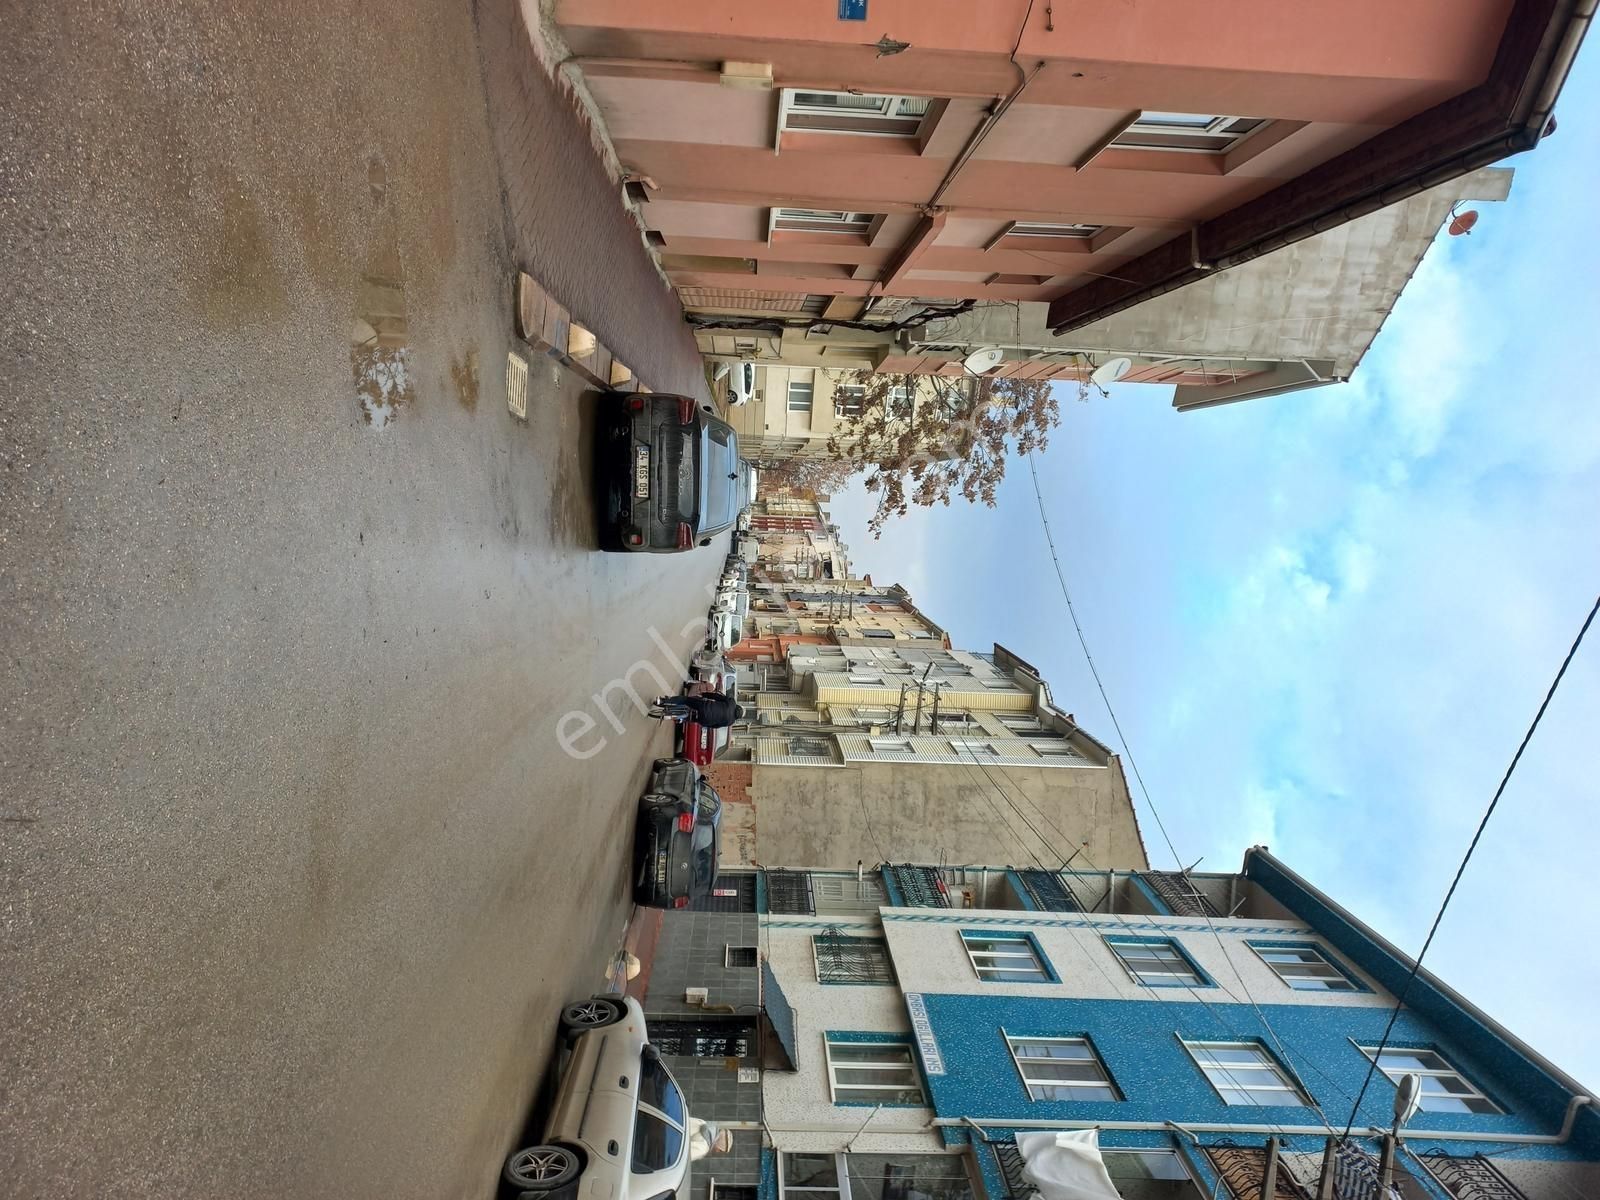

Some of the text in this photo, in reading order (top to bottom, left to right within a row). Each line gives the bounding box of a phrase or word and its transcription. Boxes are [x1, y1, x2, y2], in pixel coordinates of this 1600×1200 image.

[639, 451, 648, 496] 34 KGS 051
